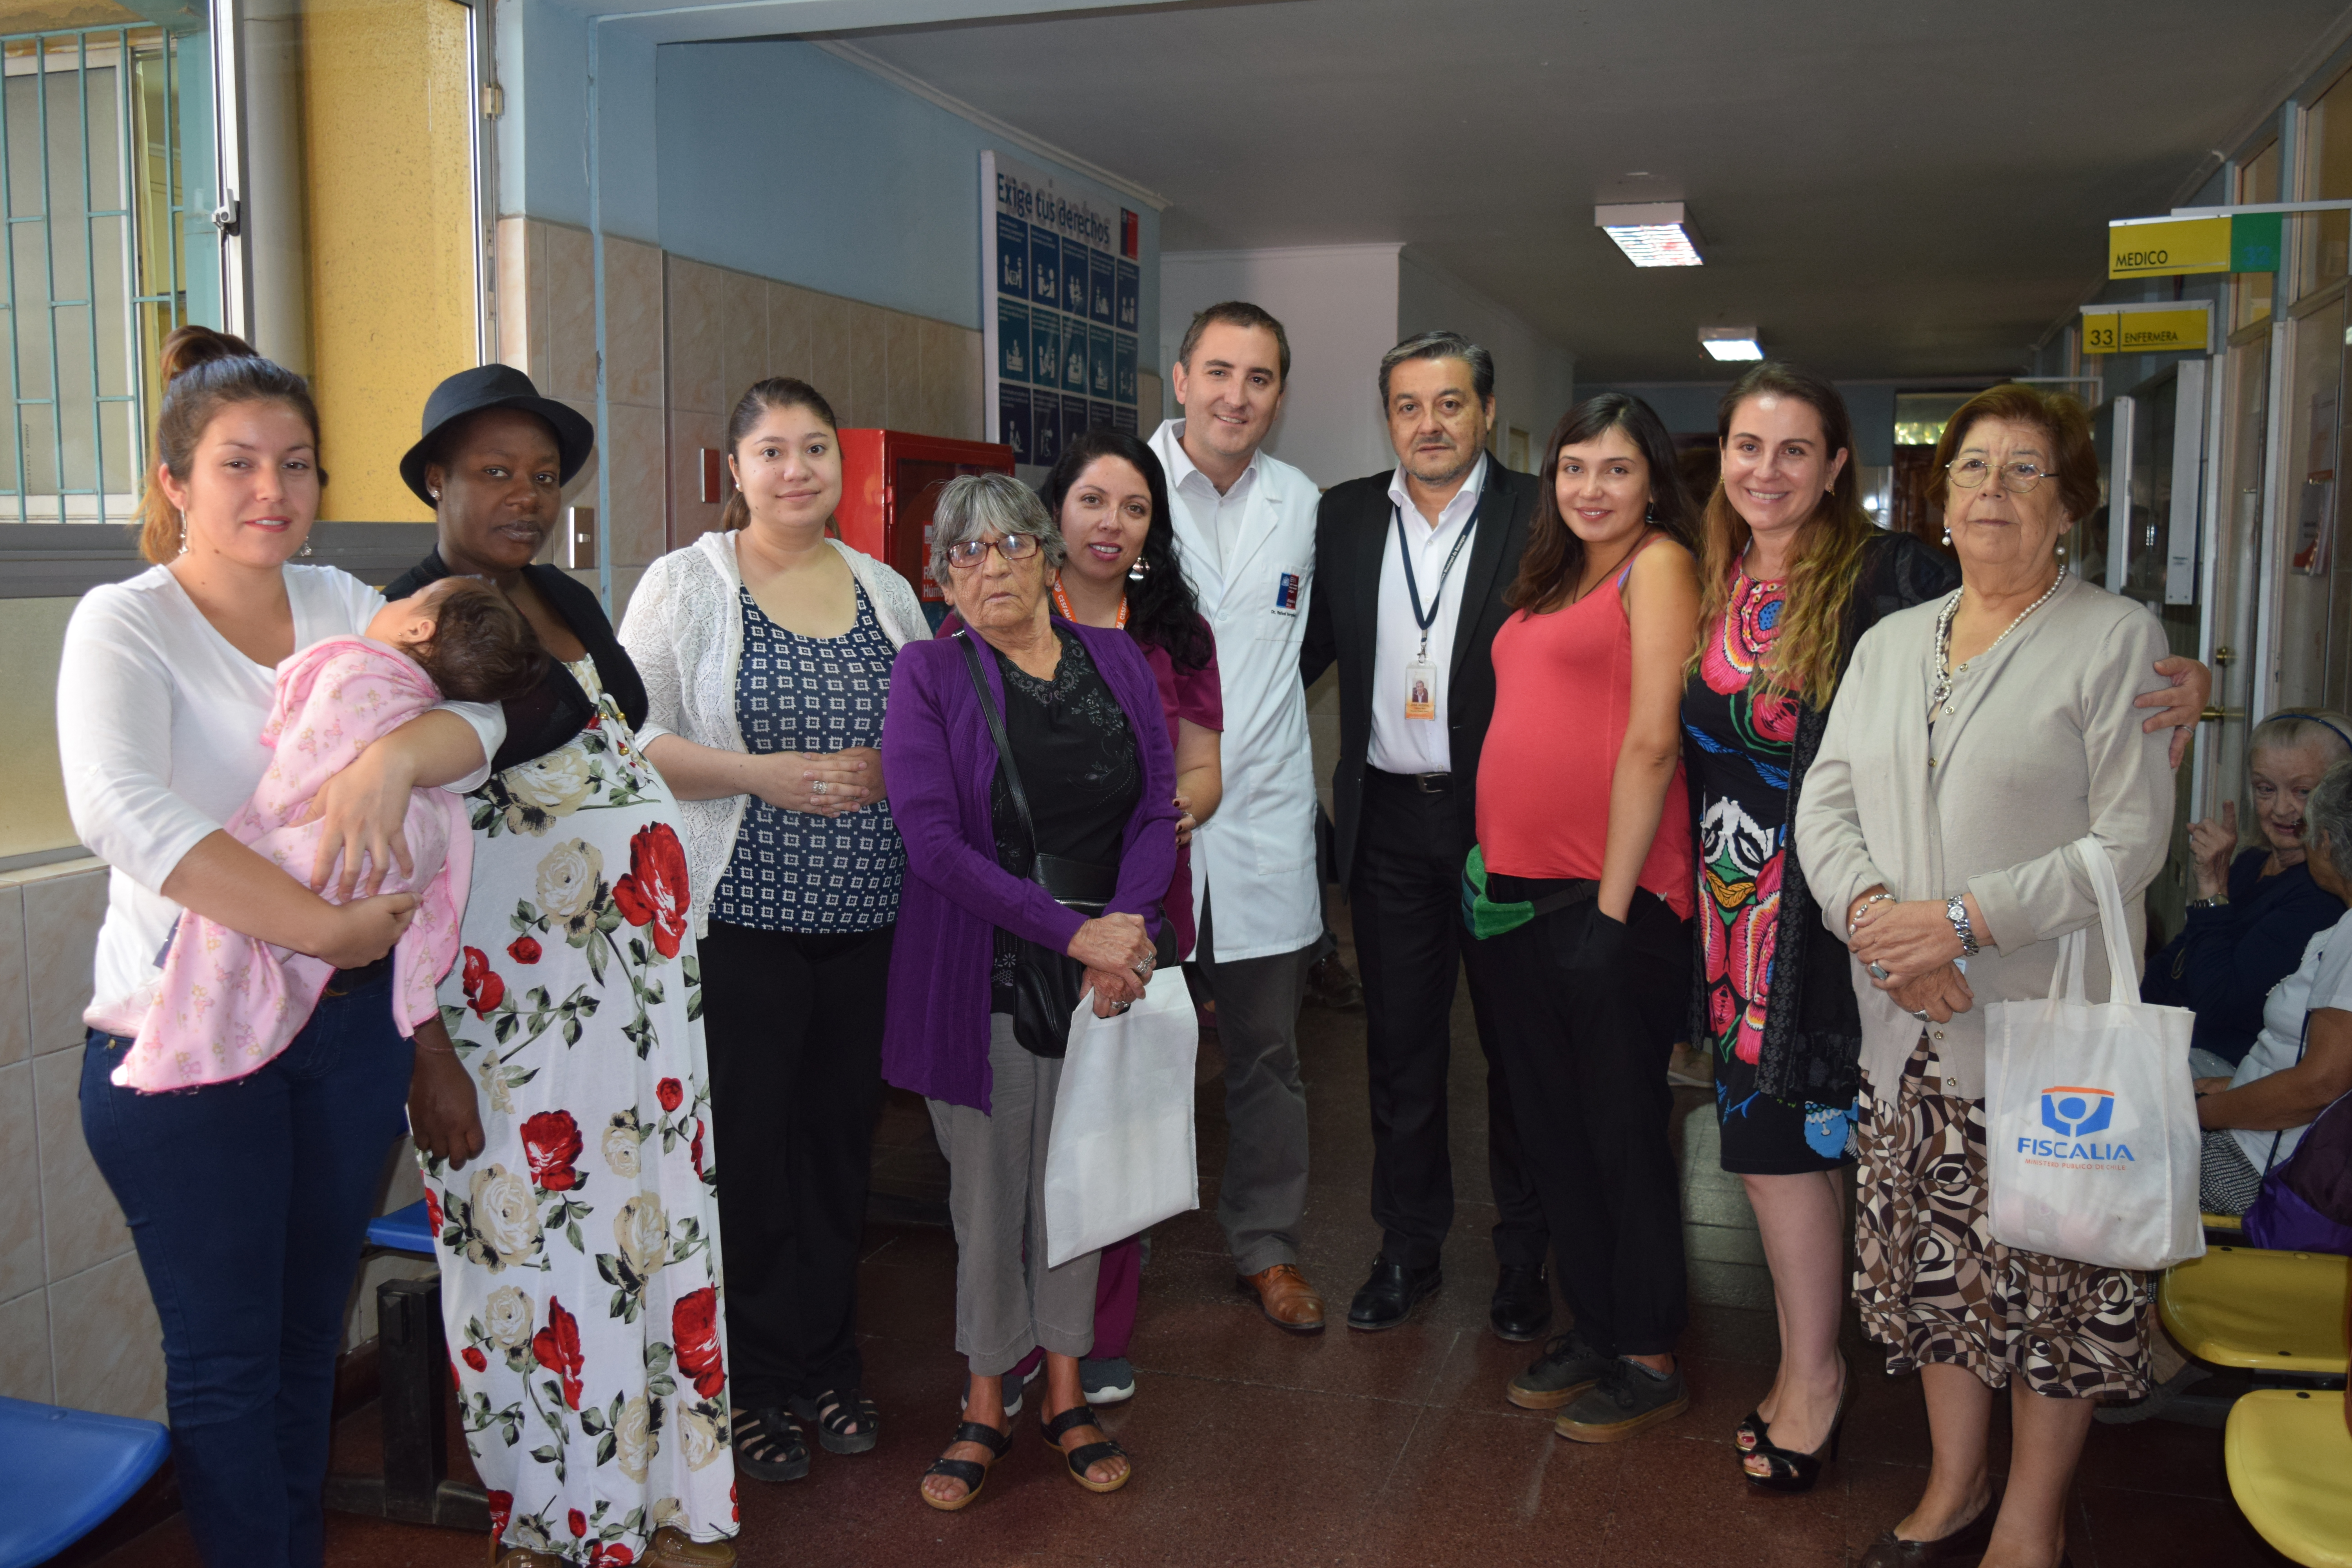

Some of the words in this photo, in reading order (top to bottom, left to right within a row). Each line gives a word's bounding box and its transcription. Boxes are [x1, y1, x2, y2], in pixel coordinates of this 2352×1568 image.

[997, 172, 1033, 218] Exige
[1036, 192, 1055, 223] tus
[1059, 200, 1110, 244] derechos
[2116, 250, 2168, 267] MEDICO
[2243, 245, 2270, 265] 32
[2090, 329, 2113, 345] 33
[2125, 331, 2178, 343] ENFERMERA
[924, 584, 944, 598] Húme
[1058, 595, 1071, 618] CESFAM
[2017, 1137, 2135, 1161] FISCALIA
